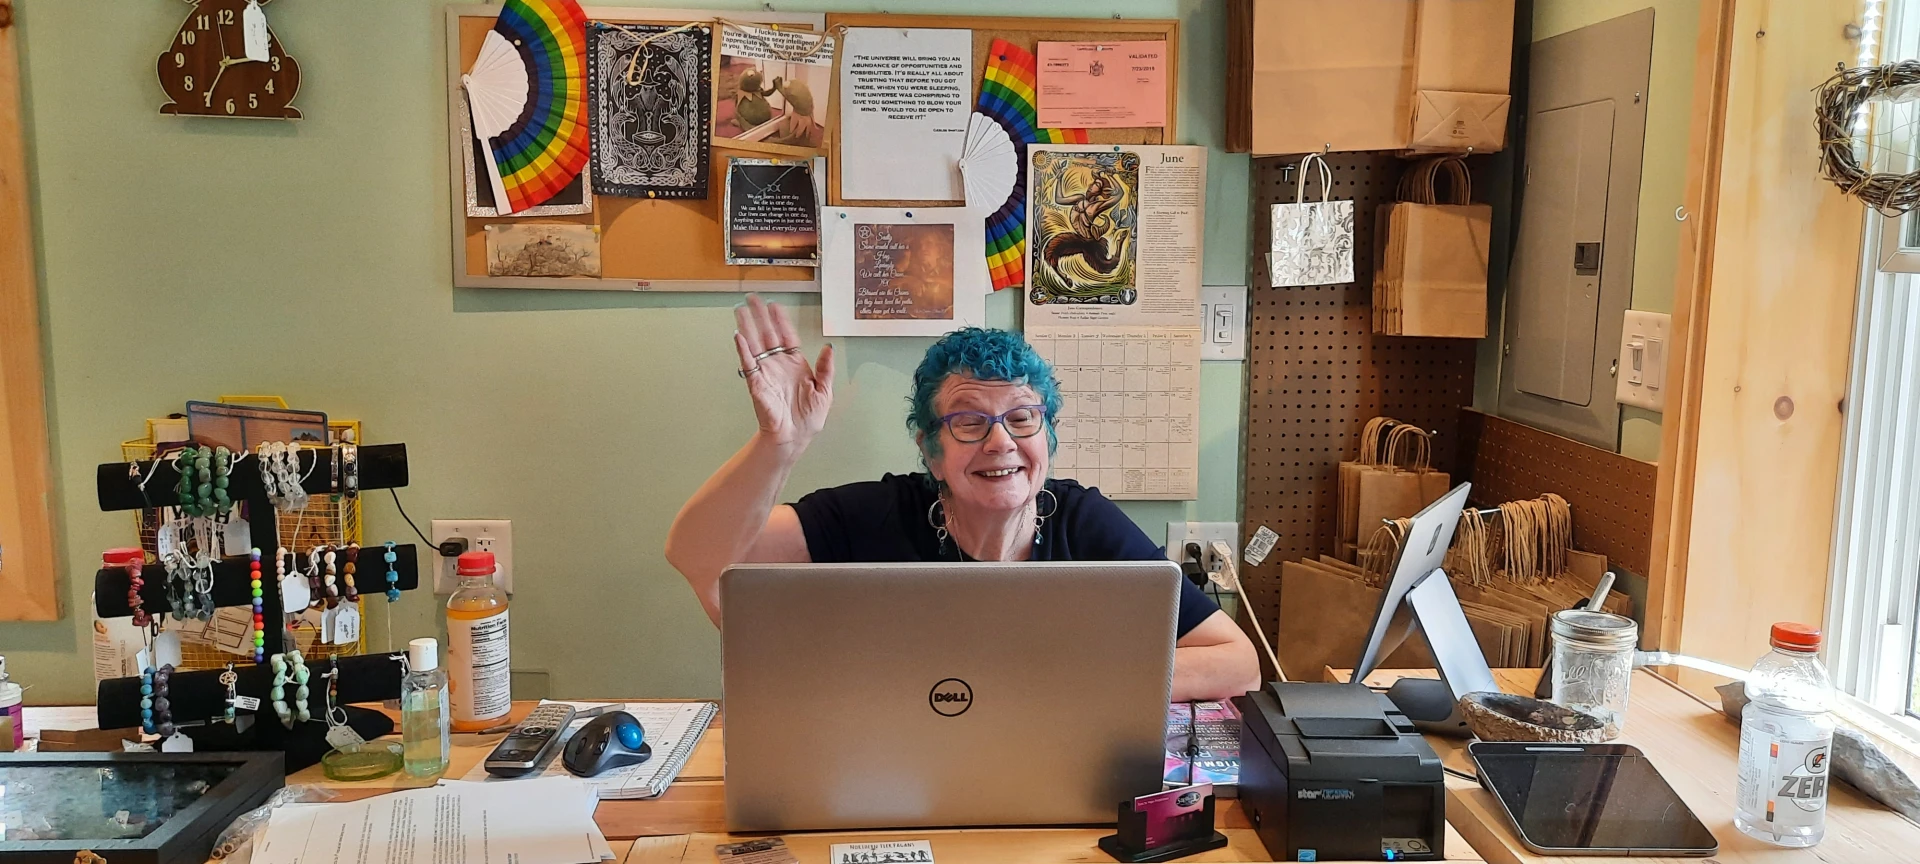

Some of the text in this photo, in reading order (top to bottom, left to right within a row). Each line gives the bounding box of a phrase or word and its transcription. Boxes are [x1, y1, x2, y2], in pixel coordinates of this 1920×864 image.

[197, 15, 209, 30] 11
[218, 9, 234, 25] 12
[181, 31, 195, 45] 10
[175, 53, 184, 68] 9
[271, 56, 280, 72] 3
[184, 76, 193, 91] 8
[265, 79, 274, 94] 4
[204, 92, 211, 107] 7
[226, 99, 235, 114] 6
[249, 93, 257, 108] 5
[1160, 153, 1184, 164] June
[860, 269, 872, 278] We
[935, 692, 968, 702] DELL
[1805, 746, 1827, 774] G
